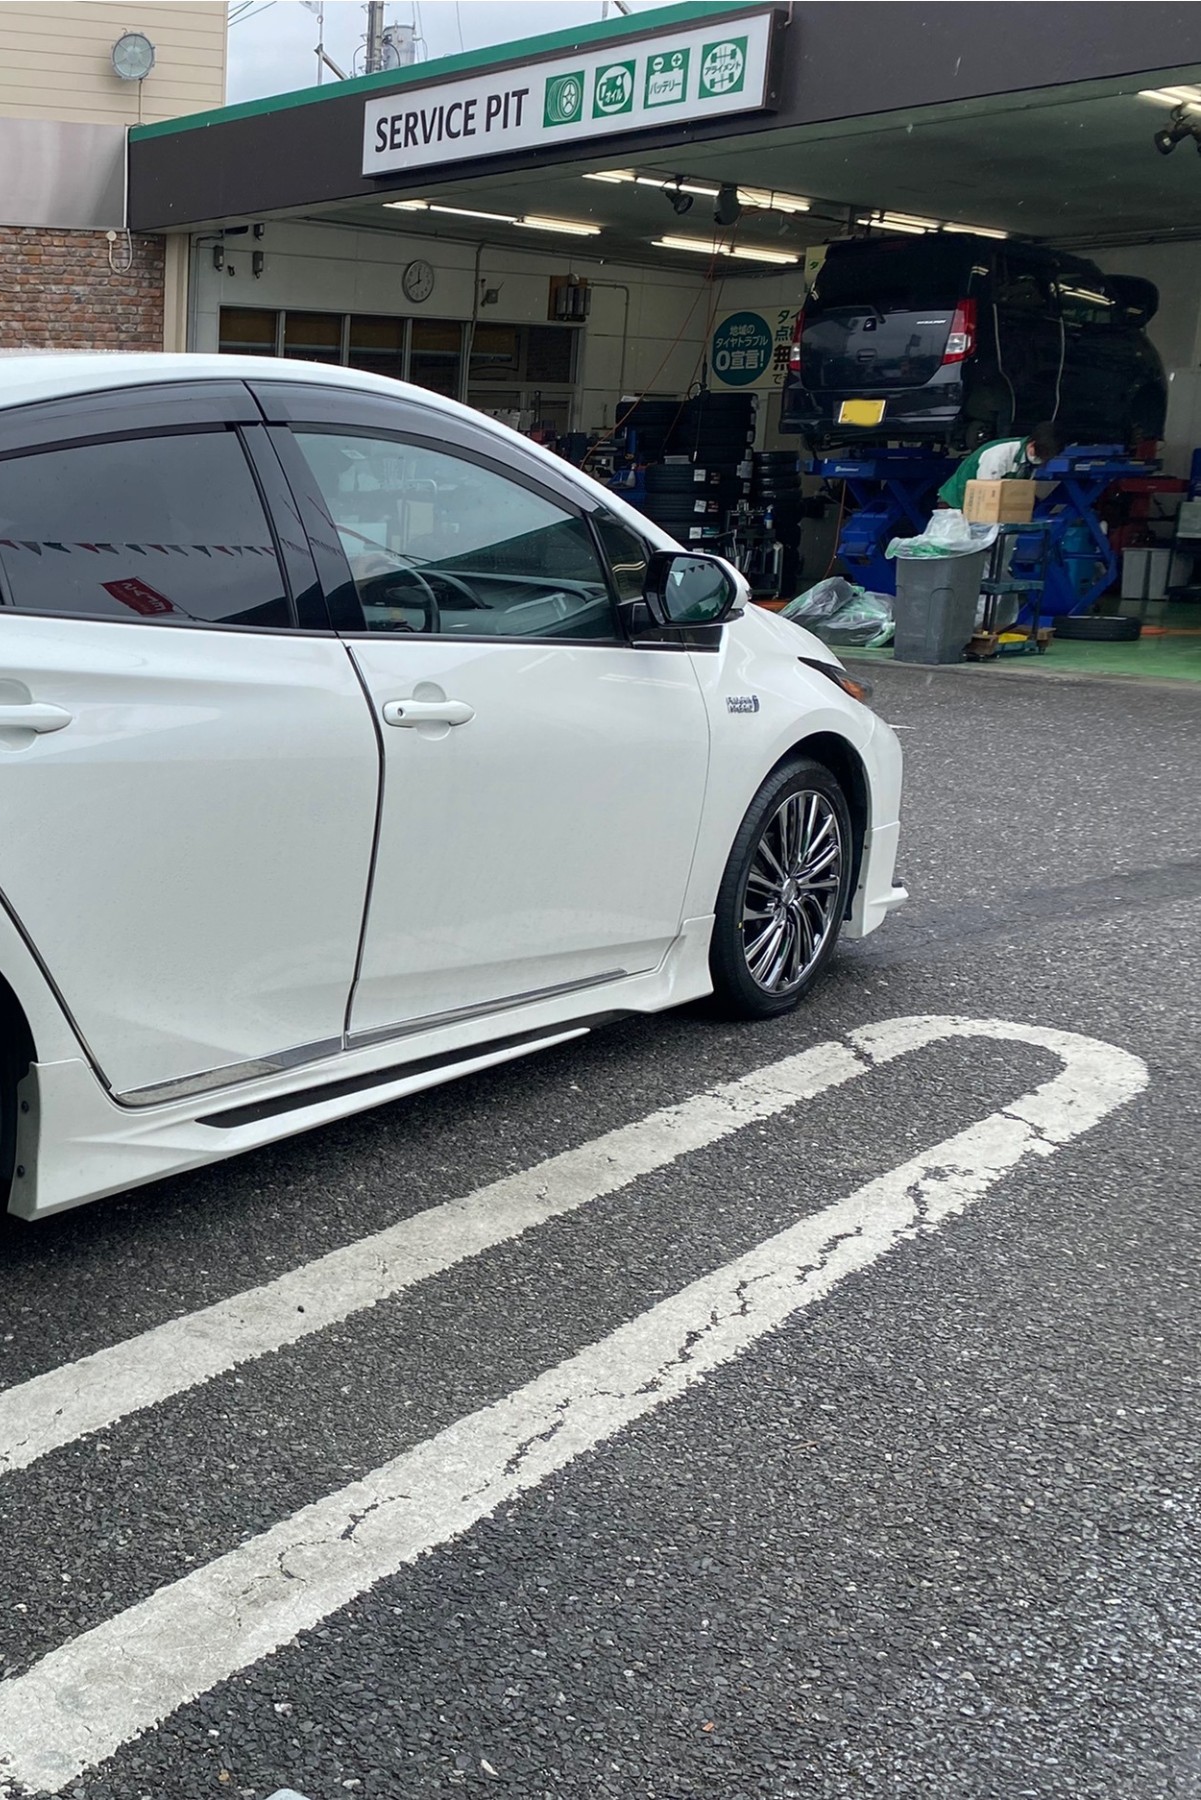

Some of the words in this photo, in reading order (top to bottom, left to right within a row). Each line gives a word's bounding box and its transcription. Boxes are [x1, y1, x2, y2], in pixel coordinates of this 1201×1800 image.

[704, 61, 741, 75] アライメント
[650, 78, 682, 94] バッテリー
[605, 88, 623, 101] オイル
[374, 98, 477, 153] SERVICE
[485, 88, 529, 132] PIT
[730, 324, 756, 336] 地域の
[715, 335, 768, 349] タイヤトラブル
